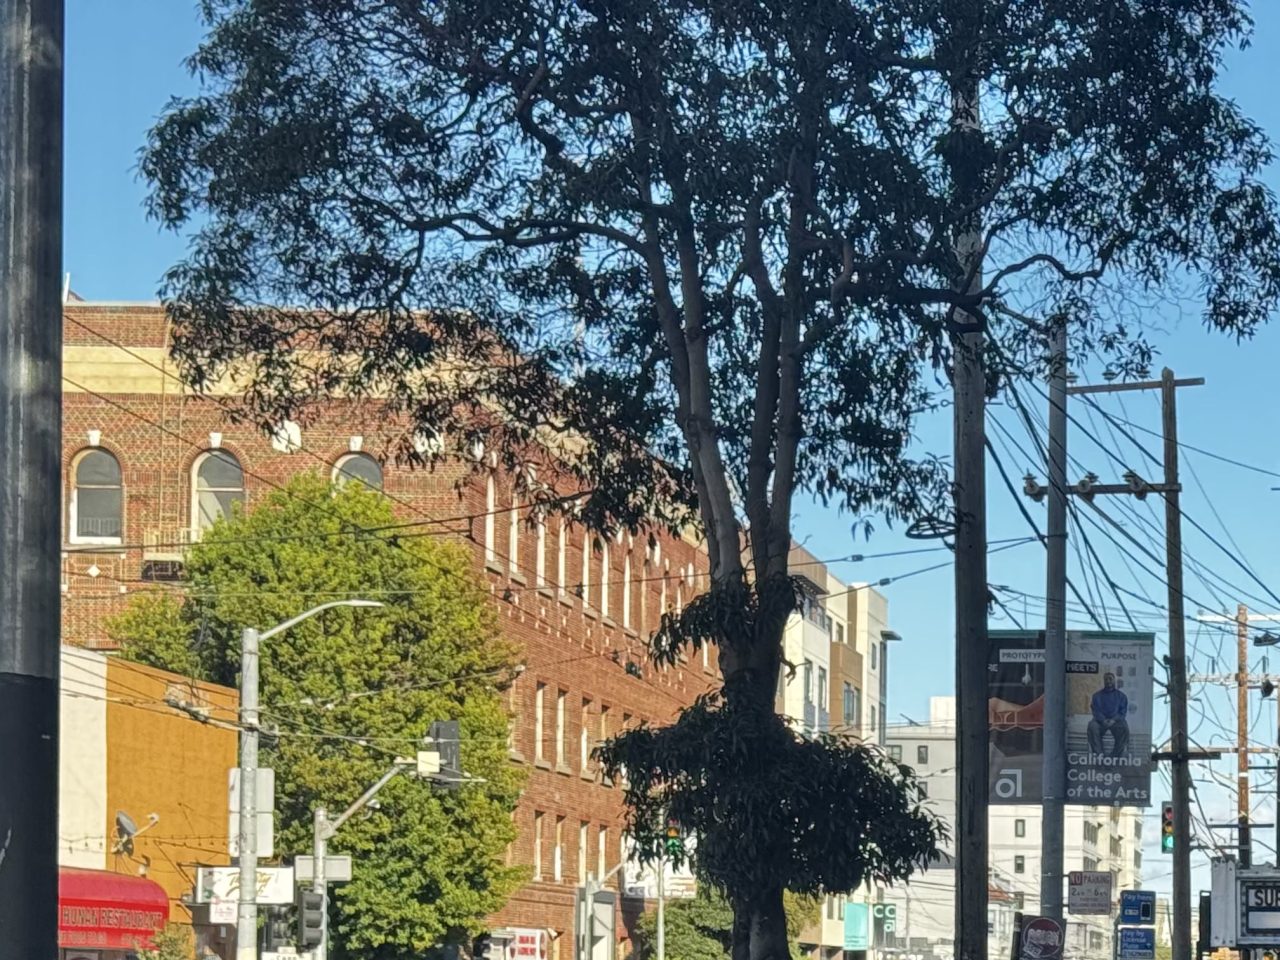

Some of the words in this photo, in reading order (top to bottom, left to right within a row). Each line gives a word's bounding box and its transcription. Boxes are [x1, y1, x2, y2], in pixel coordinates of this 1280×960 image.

[1001, 652, 1045, 661] PROTOTYP
[1101, 652, 1137, 661] PURPOSE
[1066, 663, 1097, 672] MEETS
[1067, 753, 1142, 767] California
[1067, 769, 1122, 785] College
[1067, 786, 1083, 798] of
[1086, 786, 1112, 798] the
[1115, 786, 1148, 799] Arts
[100, 907, 163, 930] RESTAURANT
